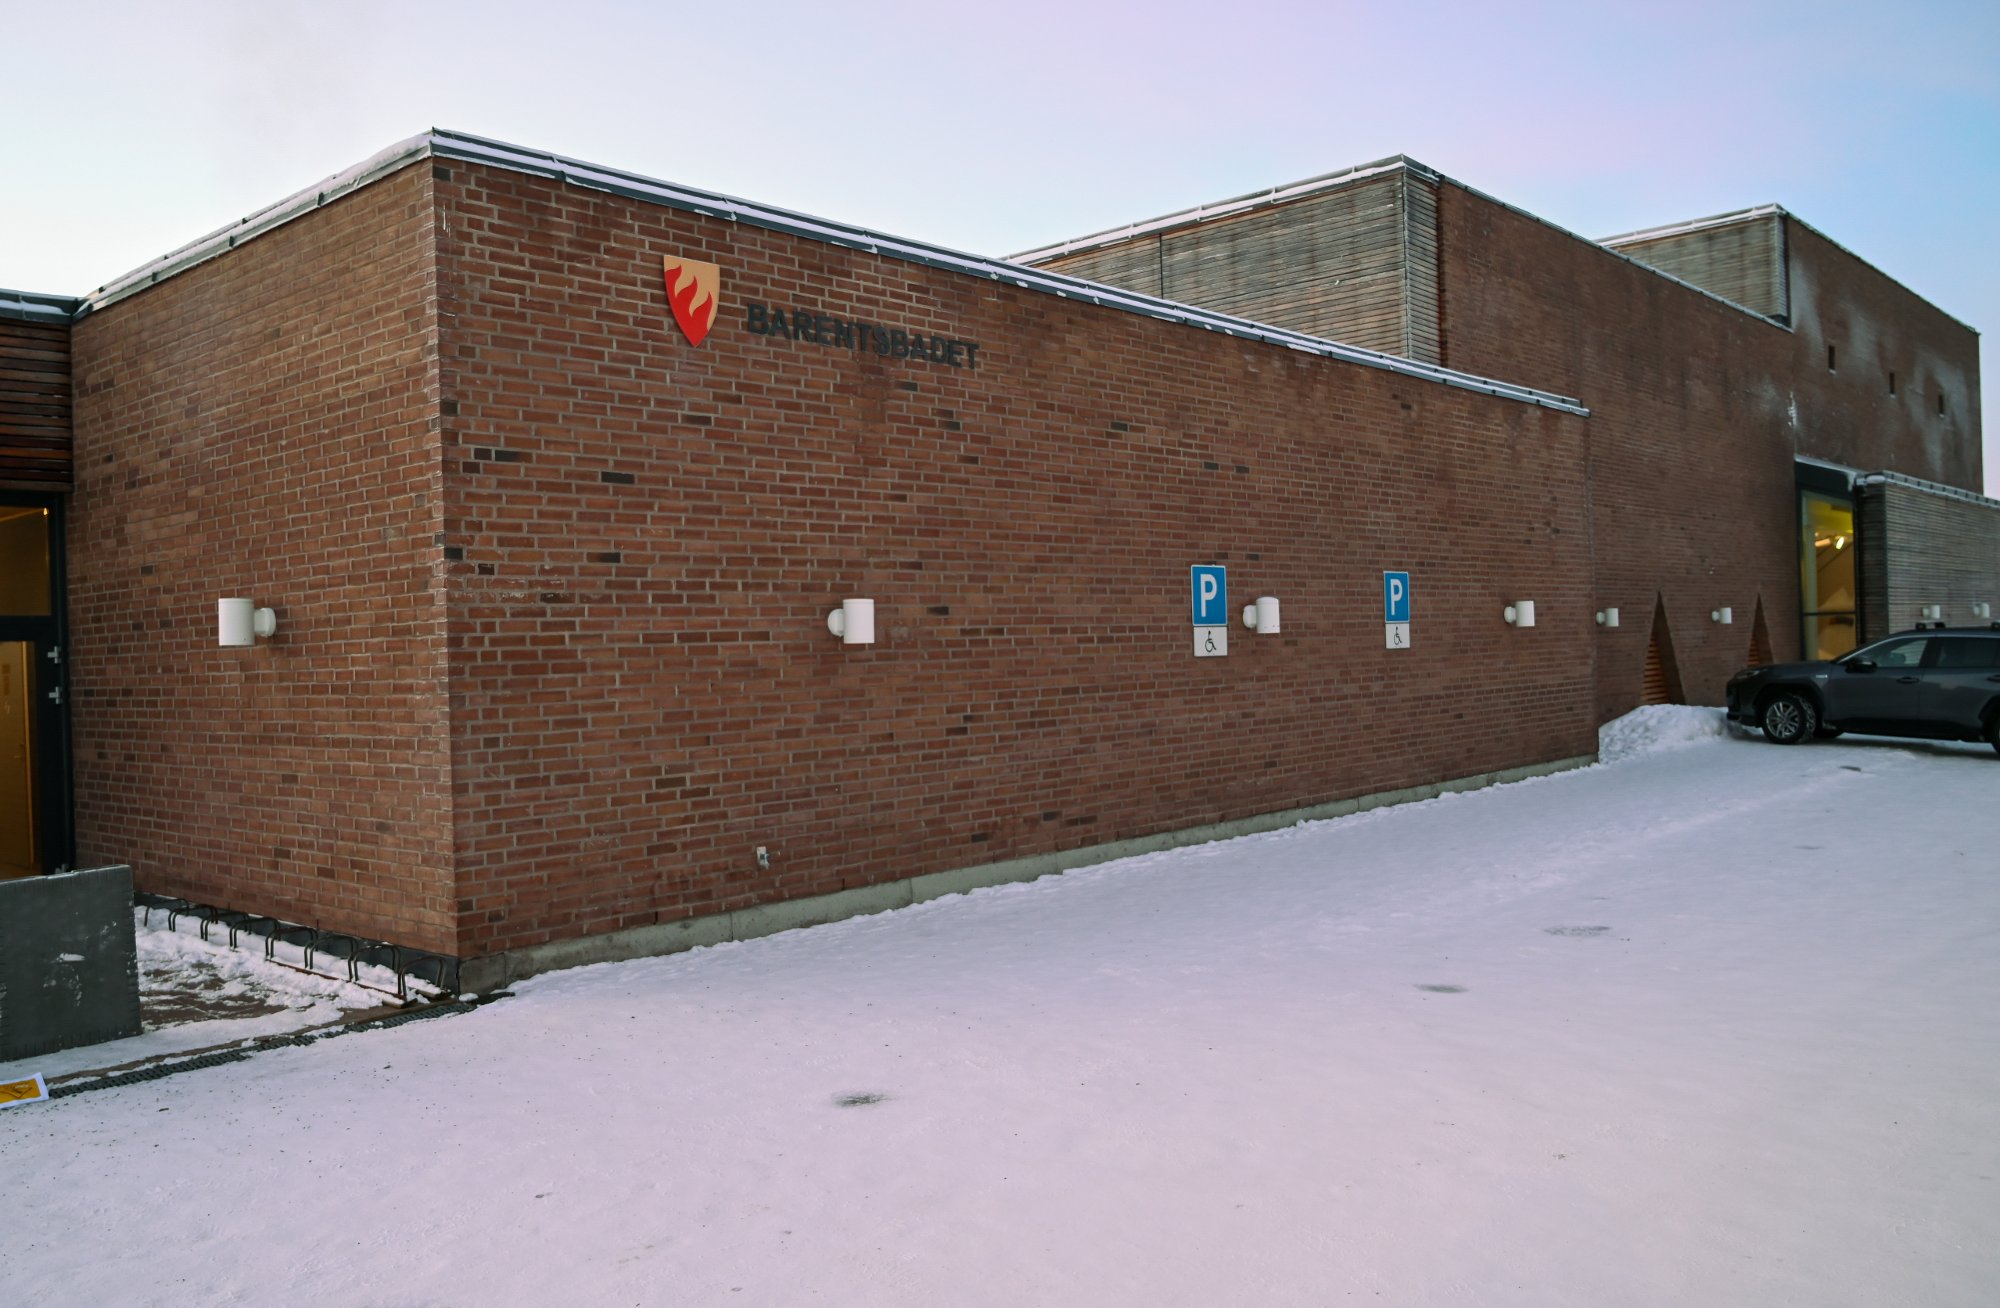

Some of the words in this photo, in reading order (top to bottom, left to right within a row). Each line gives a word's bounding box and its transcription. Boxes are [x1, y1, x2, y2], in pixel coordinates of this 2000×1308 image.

[747, 303, 979, 370] BARENTSBADET
[1200, 573, 1218, 617] P
[1390, 578, 1403, 616] P
